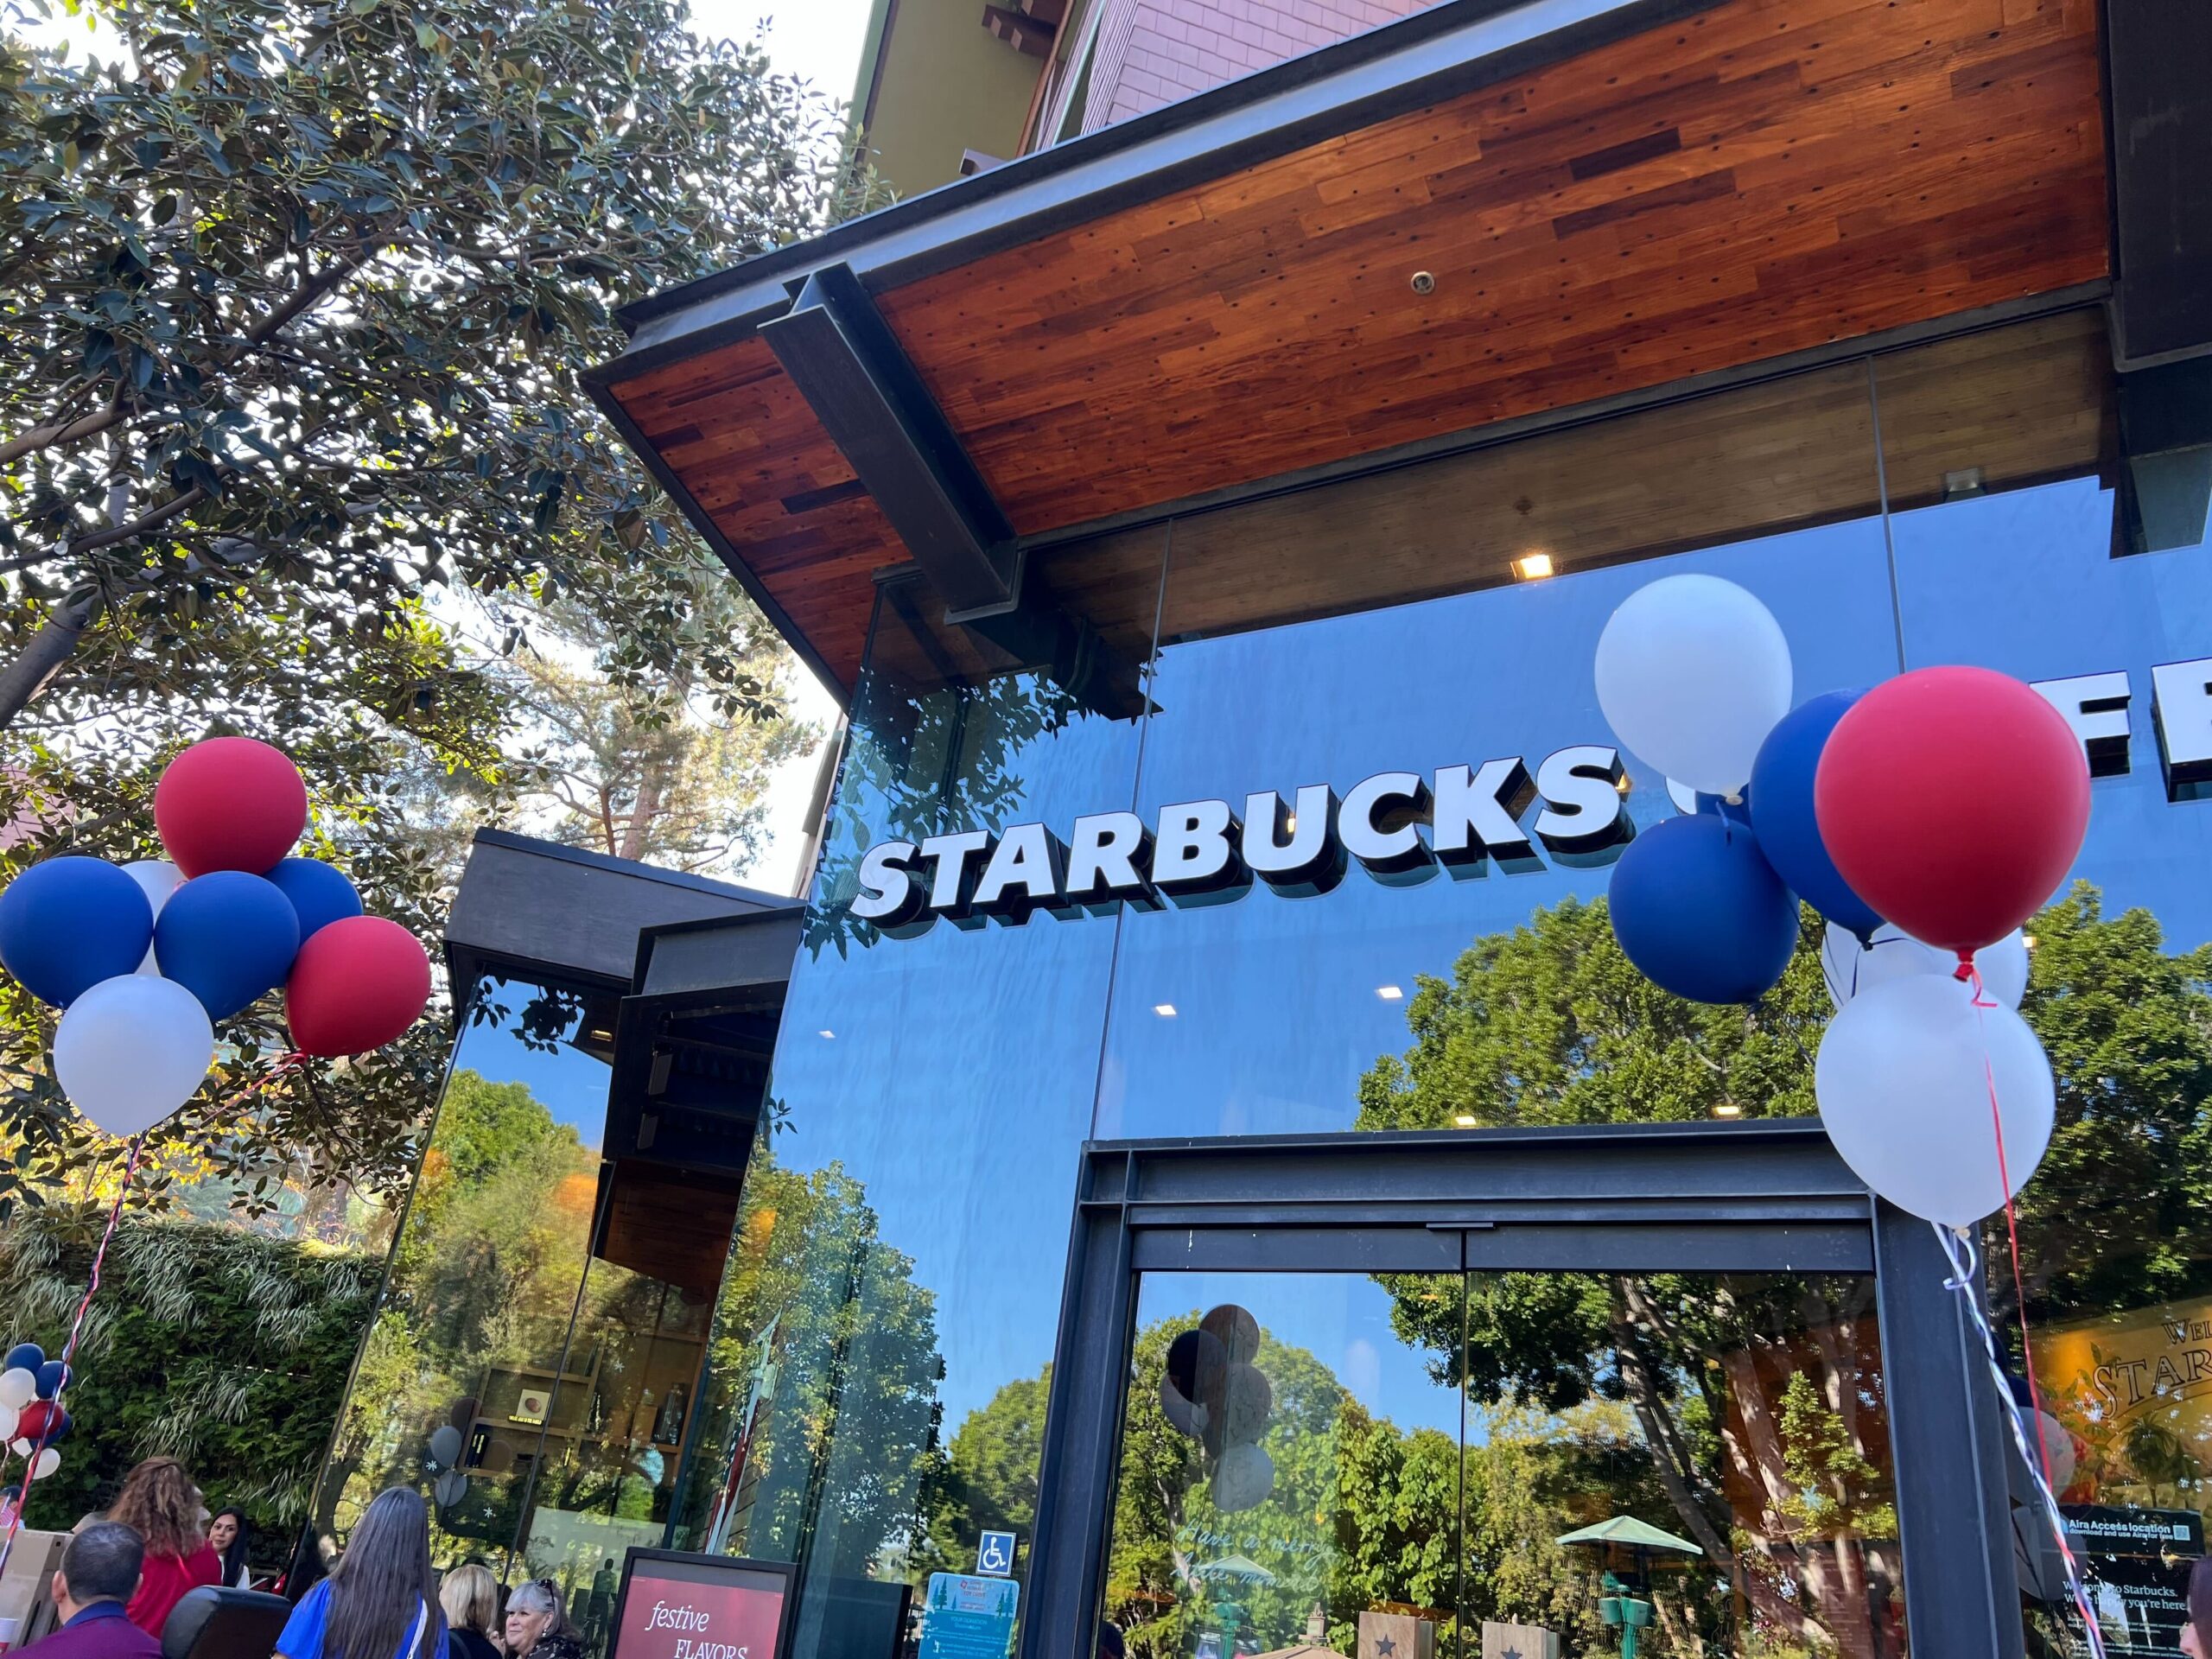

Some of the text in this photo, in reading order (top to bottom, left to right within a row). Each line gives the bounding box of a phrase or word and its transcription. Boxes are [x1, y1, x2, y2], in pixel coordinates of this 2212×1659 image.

[850, 745, 1623, 923] STARBUCKS
[1175, 1518, 1234, 1546] Have
[1243, 1535, 1261, 1549] a
[2069, 1519, 2171, 1535] Aira Access location
[2069, 1528, 2103, 1536] download
[2123, 1584, 2178, 1598] Starbucks.
[2128, 1599, 2161, 1609] you're
[645, 1600, 709, 1632] festive
[674, 1638, 748, 1659] FLAVORS
